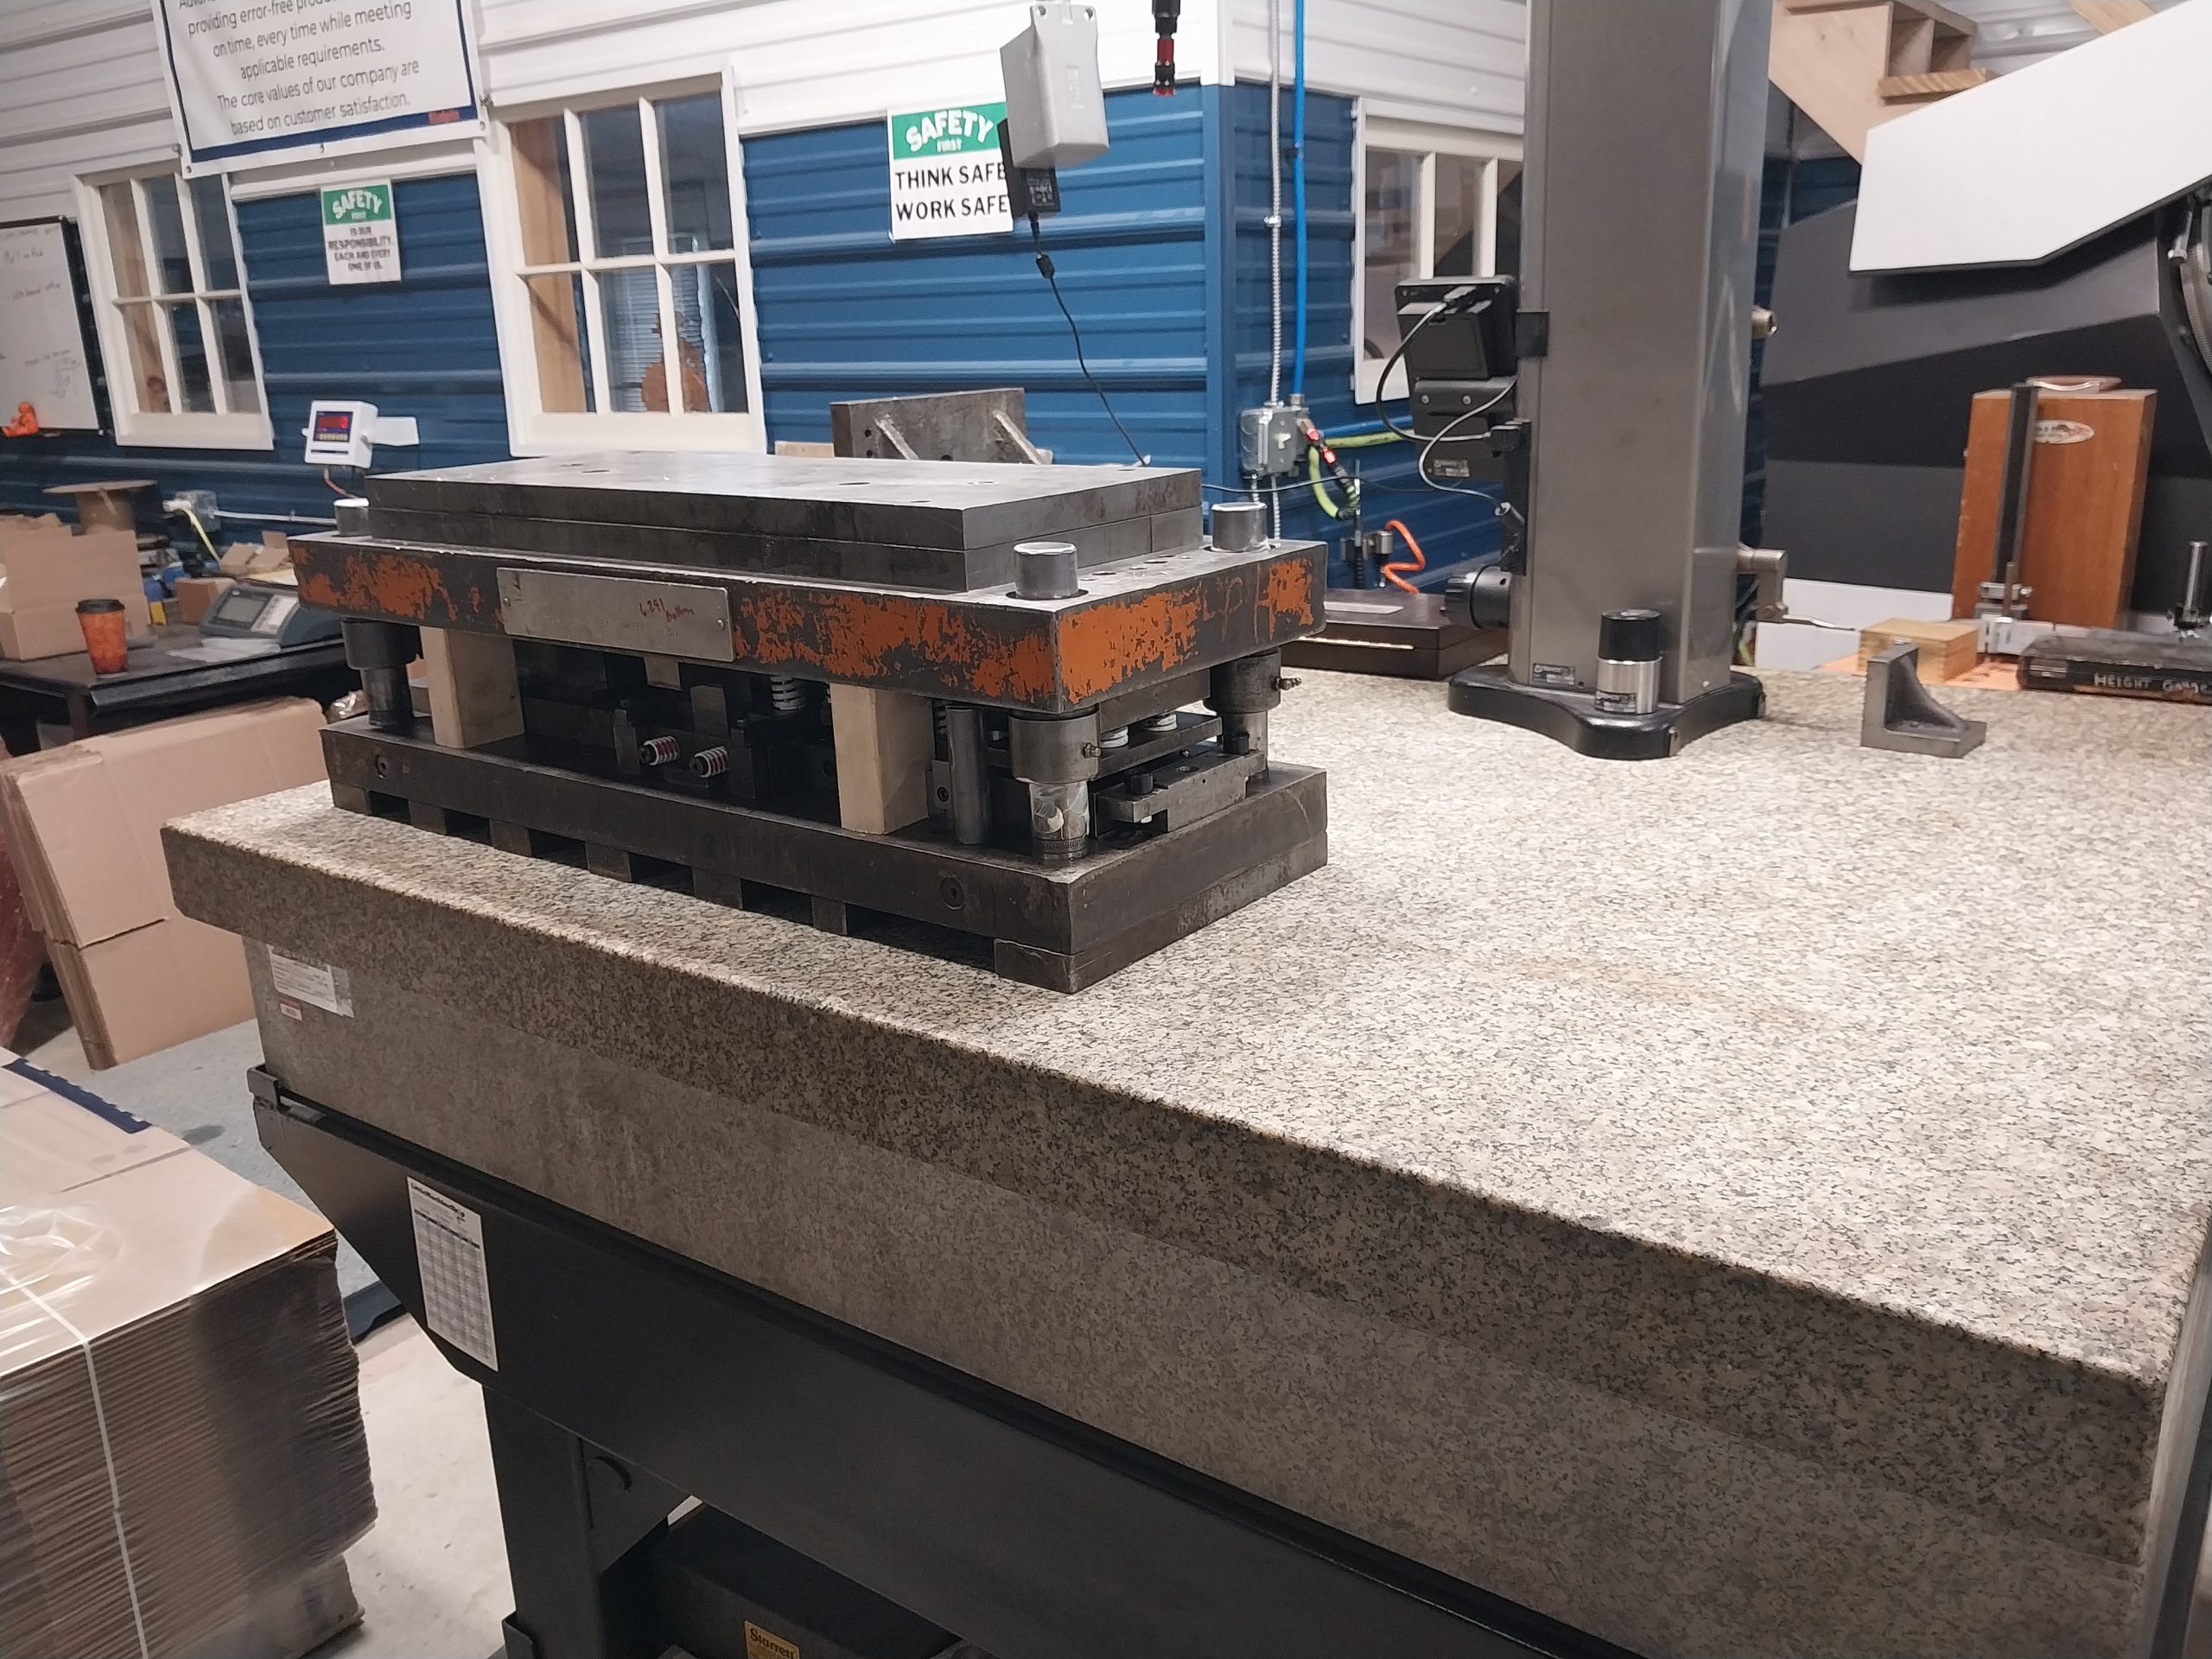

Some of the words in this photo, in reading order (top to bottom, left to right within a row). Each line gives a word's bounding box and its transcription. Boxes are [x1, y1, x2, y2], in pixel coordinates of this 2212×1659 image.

[188, 11, 238, 39] providing
[239, 2, 294, 23] error-free
[213, 44, 227, 58] on
[257, 29, 288, 48] every
[290, 22, 317, 40] time
[320, 11, 352, 34] while
[354, 1, 411, 25] meeting
[240, 54, 295, 82] applicable
[297, 38, 386, 68] requirements.
[217, 93, 238, 111] The
[241, 91, 264, 107] core
[265, 83, 301, 102] values
[302, 76, 314, 95] of
[316, 77, 337, 92] our
[340, 66, 398, 88] company
[401, 60, 420, 77] are
[230, 114, 264, 136] based
[267, 116, 282, 130] on
[283, 105, 336, 127] customer
[340, 92, 411, 118] satisfaction.
[906, 109, 995, 153] SAFETY
[937, 138, 963, 152] FIRST
[895, 167, 953, 190] THINK
[958, 162, 1006, 185] SAFE
[333, 190, 382, 219] SAFETY
[896, 199, 957, 222] WORK
[961, 194, 1008, 216] SAFE
[2093, 672, 2152, 690] HEIGHT
